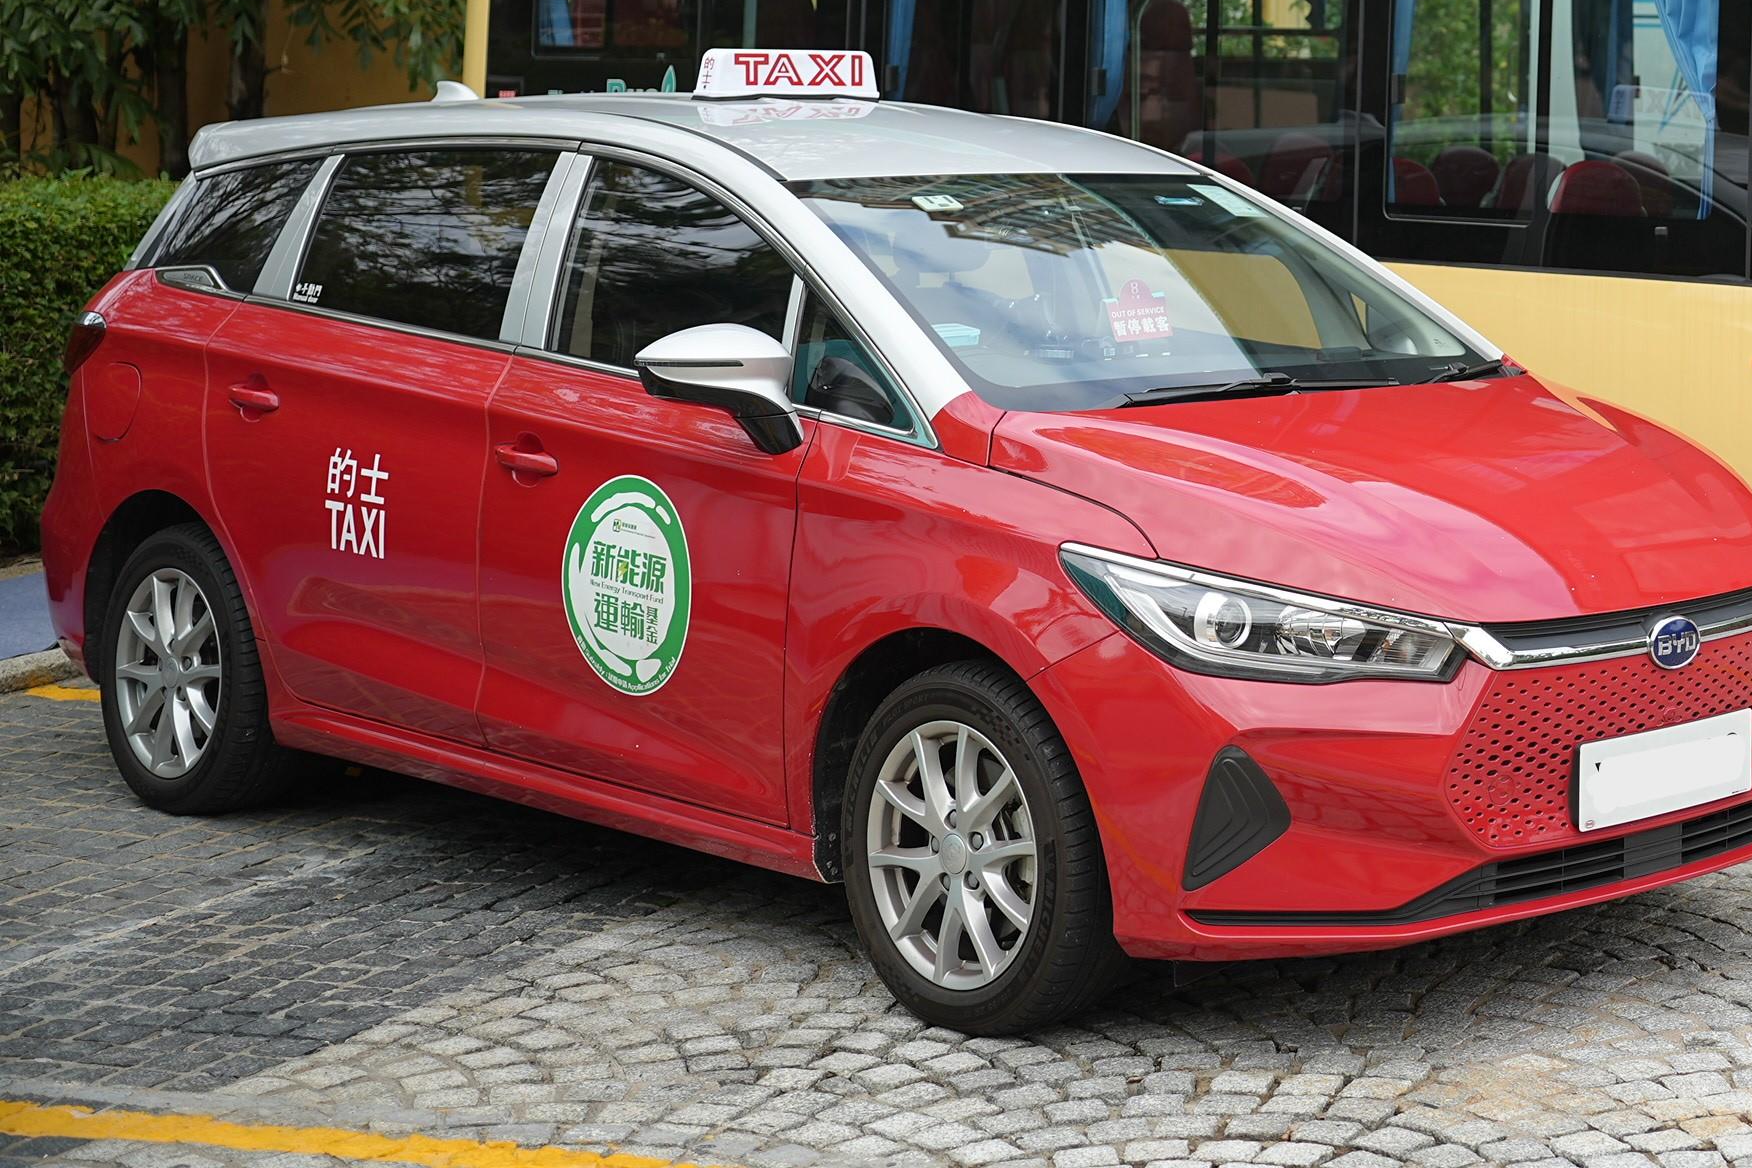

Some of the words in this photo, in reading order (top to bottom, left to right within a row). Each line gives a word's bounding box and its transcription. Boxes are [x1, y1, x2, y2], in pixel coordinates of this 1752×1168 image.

[734, 53, 864, 87] TAXI
[1111, 310, 1126, 319] OUT
[1126, 308, 1136, 317] OF
[1136, 306, 1165, 316] SERVICE
[327, 447, 390, 504] 的士
[325, 499, 386, 559] TAXI
[591, 540, 667, 594] 新能源
[601, 580, 621, 594] Energy
[622, 586, 649, 602] Transport
[649, 594, 664, 605] Fund
[594, 592, 645, 641] 運輸
[646, 605, 659, 645] 基金
[1657, 631, 1697, 656] BYD
